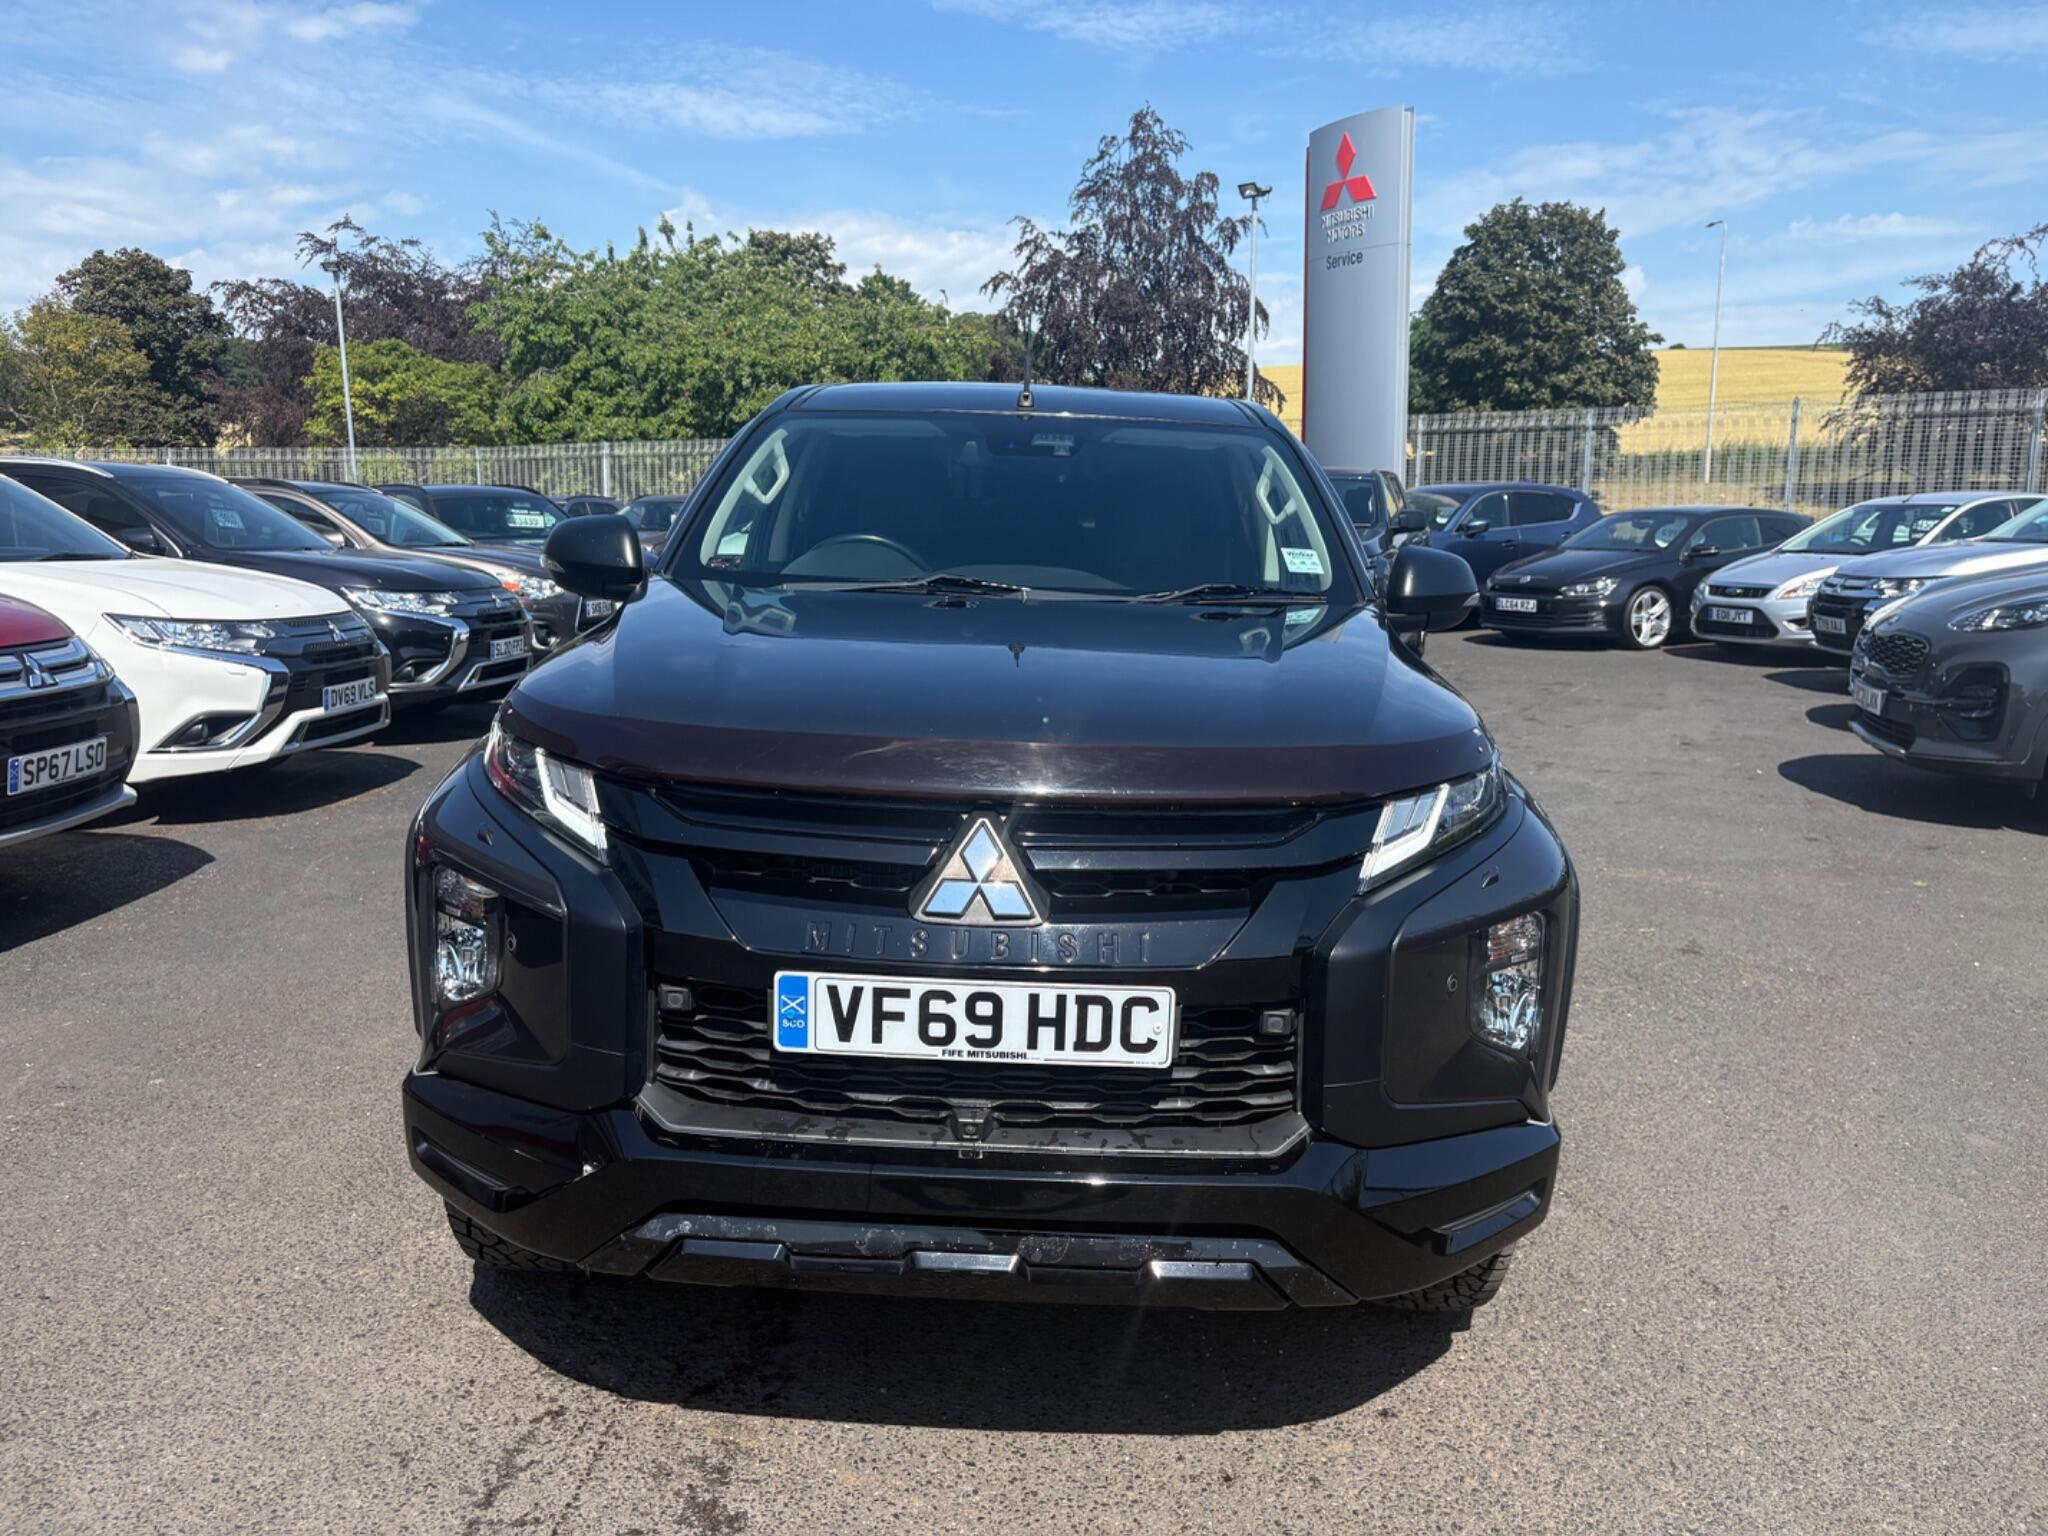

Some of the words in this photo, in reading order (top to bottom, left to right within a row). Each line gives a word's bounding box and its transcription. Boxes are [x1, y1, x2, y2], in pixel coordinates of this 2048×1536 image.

[1321, 204, 1375, 229] MITSUBISHI
[1327, 223, 1365, 243] MOTORS
[1326, 250, 1363, 270] Service
[330, 684, 356, 708] DV69
[357, 680, 375, 701] VLS
[23, 750, 71, 786] SP67
[75, 742, 105, 774] LSO
[805, 920, 1152, 964] MITSUBISHI
[826, 984, 1003, 1049] VF69
[1026, 992, 1160, 1055] HDC
[941, 1049, 964, 1058] FIFE
[967, 1050, 1028, 1060] MITSUBISHI
